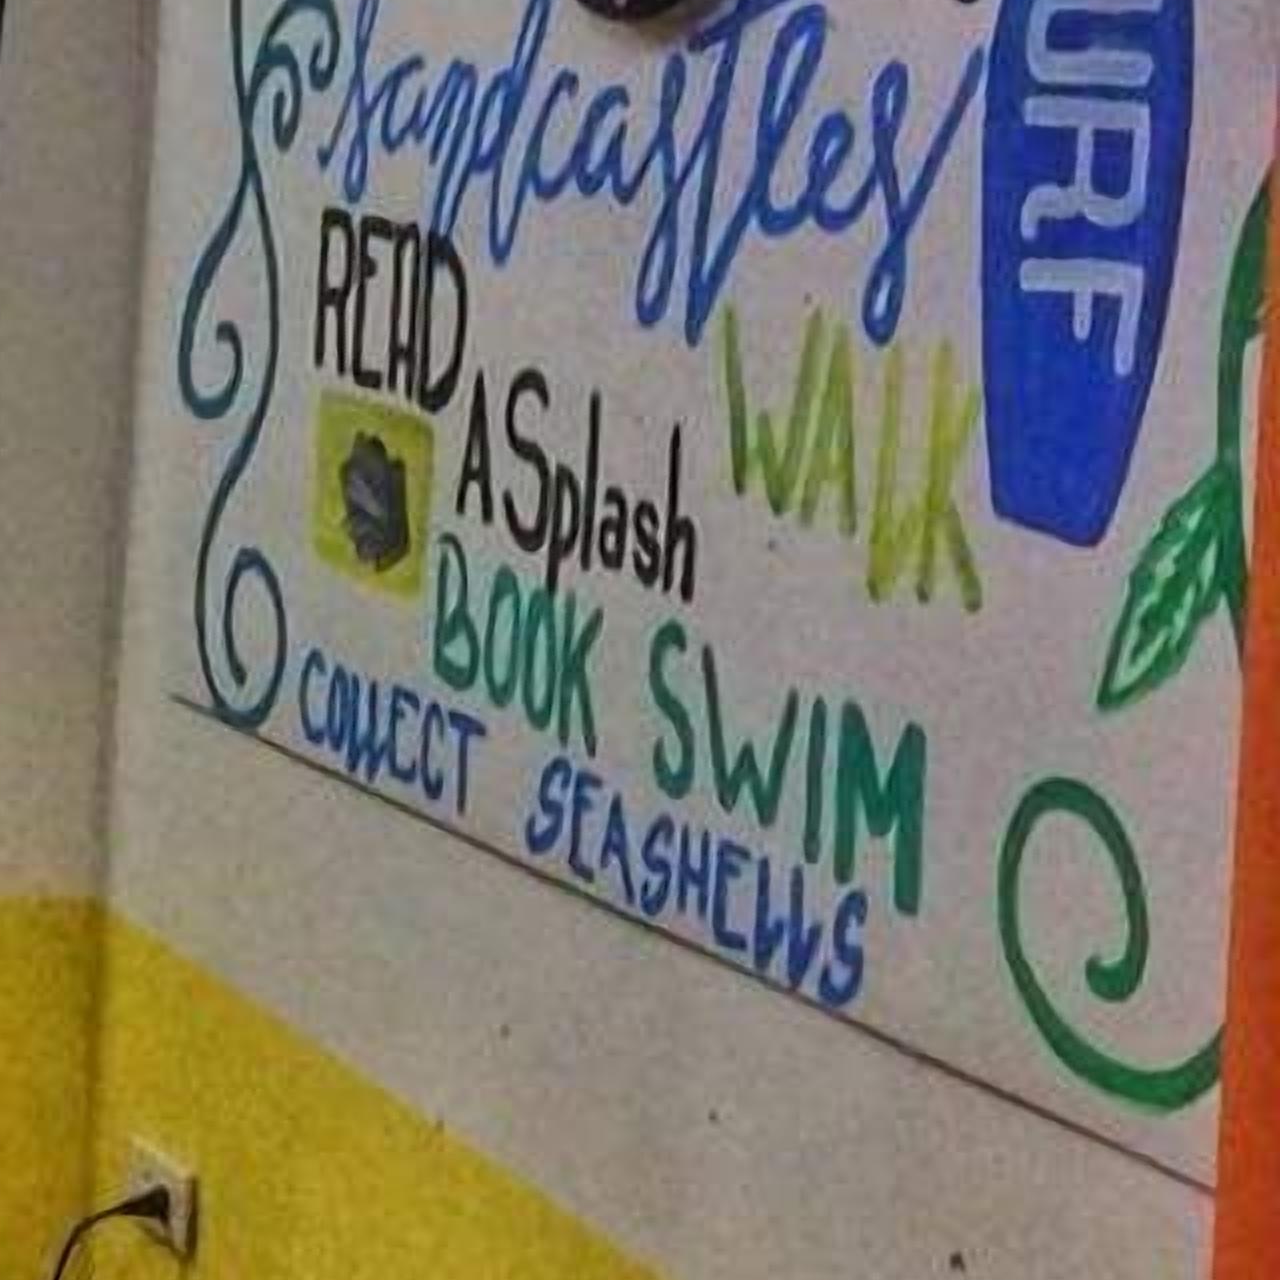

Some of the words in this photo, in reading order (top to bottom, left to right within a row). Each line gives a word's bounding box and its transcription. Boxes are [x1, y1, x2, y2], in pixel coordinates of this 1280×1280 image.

[314, 207, 469, 413] READ
[722, 304, 985, 613] WALK
[298, 647, 488, 818] COLLECT
[525, 754, 869, 1008] SEASHELLS
[433, 531, 605, 760] BOOK
[648, 618, 929, 918] SWIM
